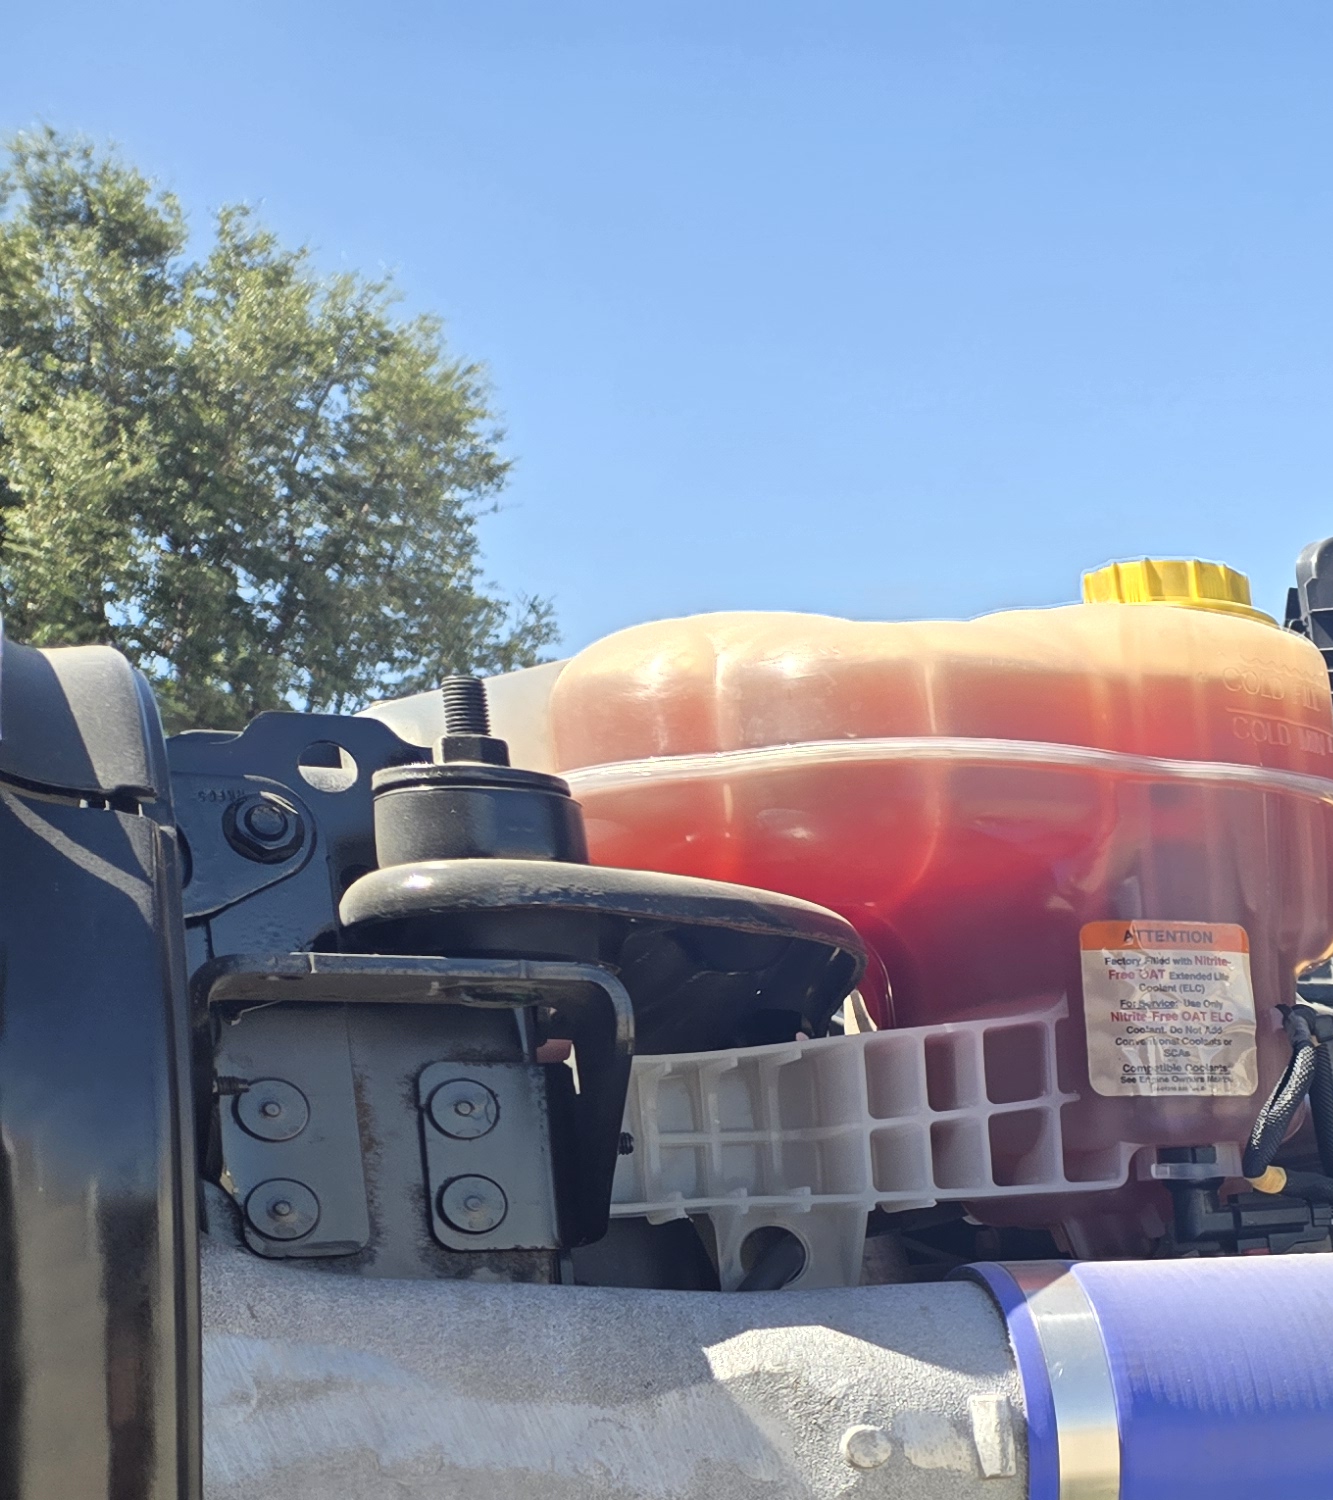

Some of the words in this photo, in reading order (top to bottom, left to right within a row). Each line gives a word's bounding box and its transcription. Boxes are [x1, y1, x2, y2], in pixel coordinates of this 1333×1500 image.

[1222, 667, 1285, 700] COLD
[1233, 716, 1291, 746] COLD
[1124, 930, 1213, 943] ATTENTION
[1105, 957, 1141, 967] Factory
[1145, 956, 1170, 966] Filled
[1195, 956, 1231, 967] Nitrite-
[1109, 970, 1134, 980] Free
[1139, 970, 1165, 979] OAT
[1169, 972, 1211, 980] Extended
[1214, 972, 1229, 980] Life
[1139, 984, 1177, 992] Coolant
[1179, 985, 1205, 993] (ELC)
[1120, 1000, 1135, 1009] For
[1204, 1000, 1223, 1009] Only
[1181, 1012, 1207, 1021] OAT
[1211, 1012, 1233, 1021] ELC
[1170, 1026, 1182, 1034] Do
[1185, 1026, 1201, 1034] Not
[1205, 1026, 1222, 1034] Add
[1181, 1038, 1222, 1046] Coolants
[1121, 1076, 1136, 1084] See
